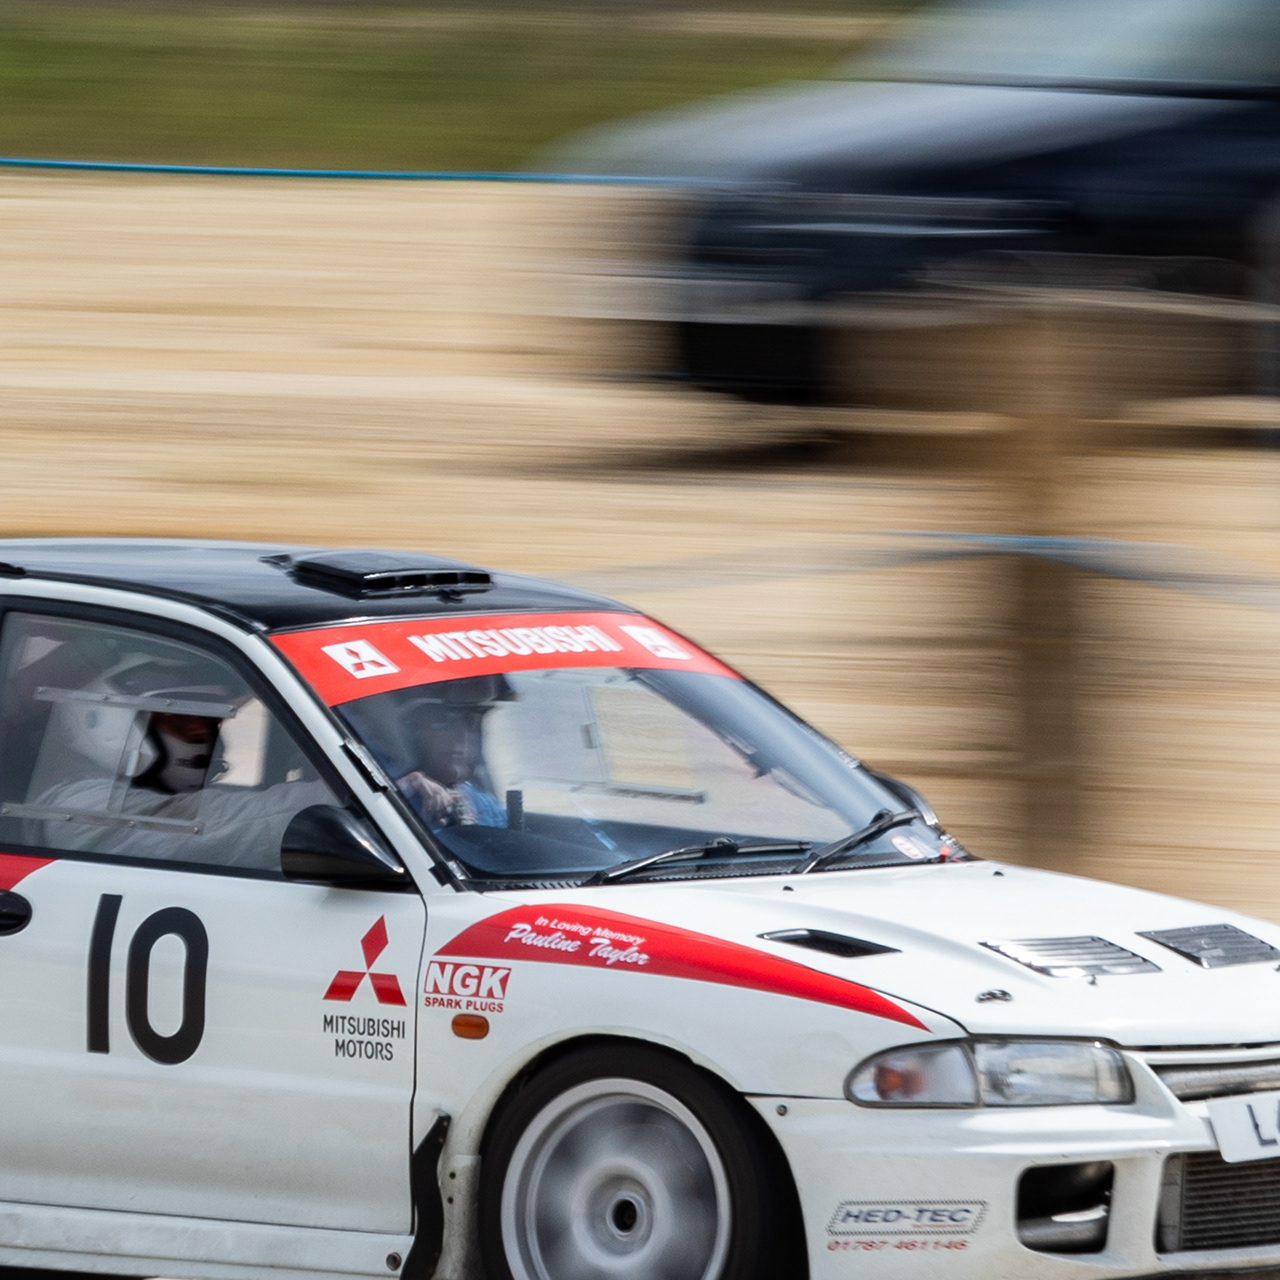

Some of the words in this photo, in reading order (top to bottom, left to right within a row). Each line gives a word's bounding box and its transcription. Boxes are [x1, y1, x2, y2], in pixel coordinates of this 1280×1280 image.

[407, 625, 624, 662] MITSUBISHI
[503, 922, 582, 953] Pauline
[587, 937, 650, 966] Taylor
[534, 916, 548, 927] In
[549, 920, 592, 936] Loving
[592, 926, 646, 945] Memory
[86, 892, 210, 1067] 10
[425, 961, 511, 999] NGK
[424, 996, 462, 1010] SPARK
[465, 1001, 504, 1013] PLUGS
[323, 1014, 406, 1039] MITSUBISHI
[335, 1038, 394, 1061] MOTORS
[839, 1208, 972, 1224] HED-TEC
